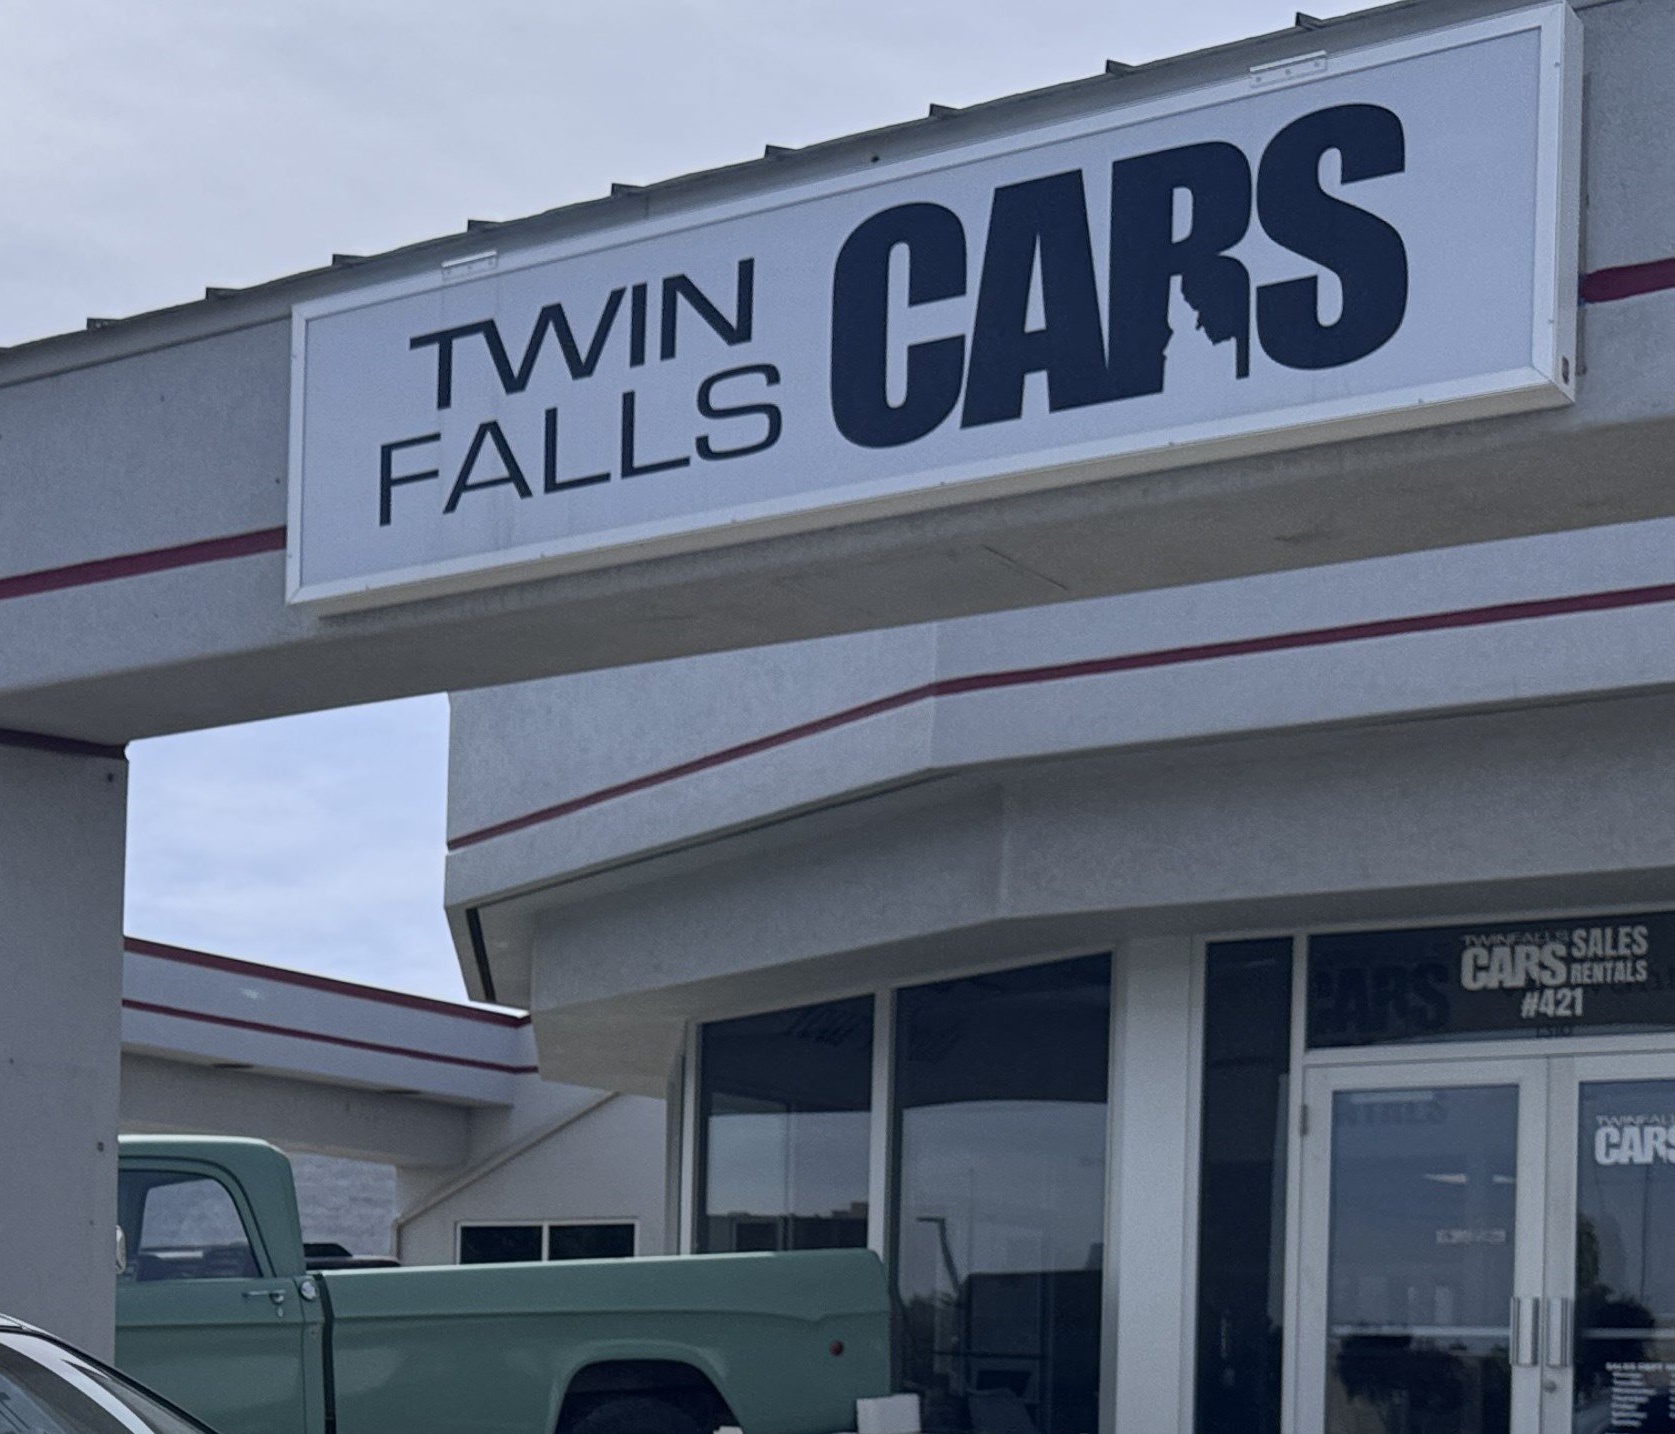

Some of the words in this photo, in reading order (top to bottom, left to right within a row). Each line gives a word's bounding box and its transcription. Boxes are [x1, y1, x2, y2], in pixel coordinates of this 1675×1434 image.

[410, 258, 754, 410] TWIN
[831, 104, 1408, 448] CARS
[380, 364, 781, 526] FALLS
[1461, 942, 1568, 991] CARS
[1570, 960, 1648, 985] RENTALS
[1572, 925, 1649, 959] SALES
[1521, 987, 1584, 1019] #421
